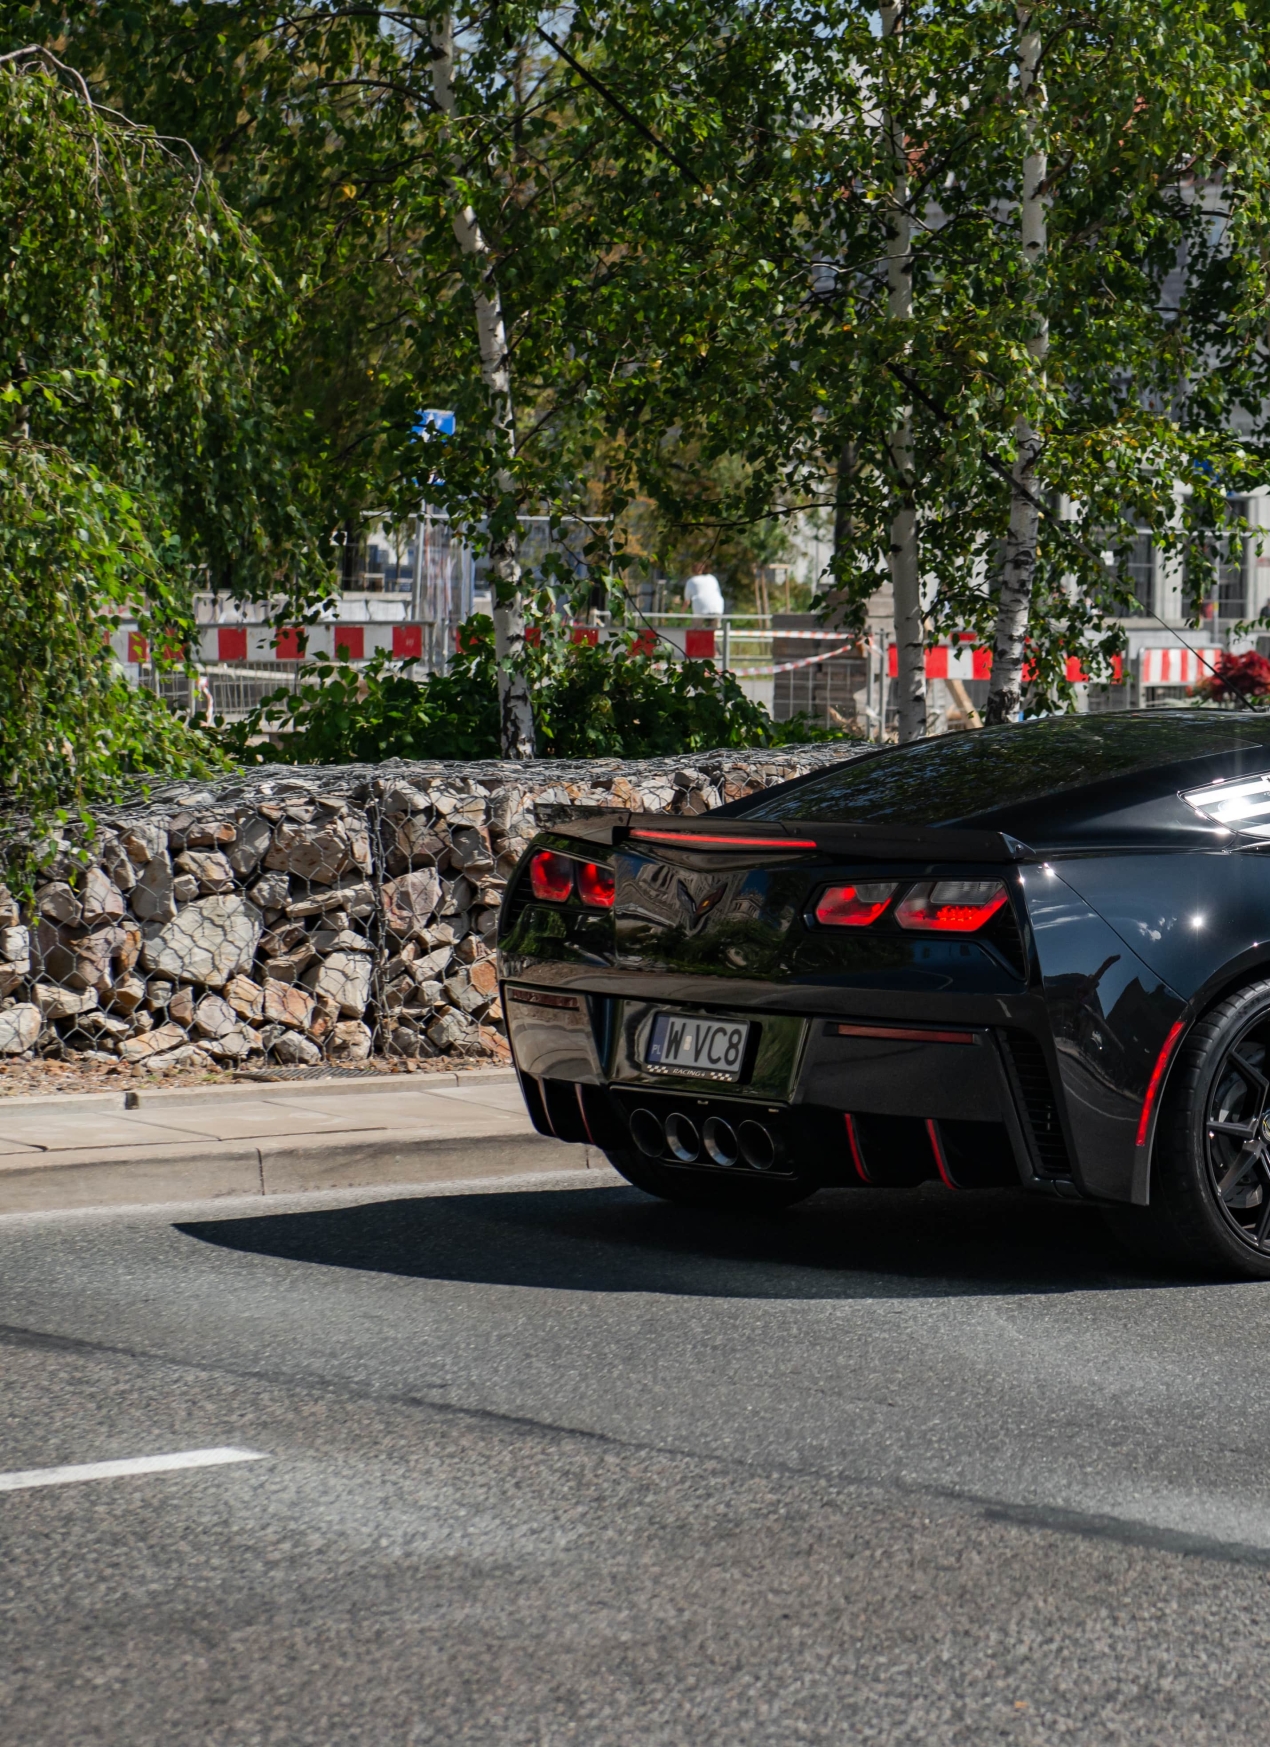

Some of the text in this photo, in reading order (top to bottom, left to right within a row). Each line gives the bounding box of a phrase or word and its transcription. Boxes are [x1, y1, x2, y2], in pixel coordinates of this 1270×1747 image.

[651, 1044, 661, 1055] PL
[665, 1021, 742, 1066] W VC8
